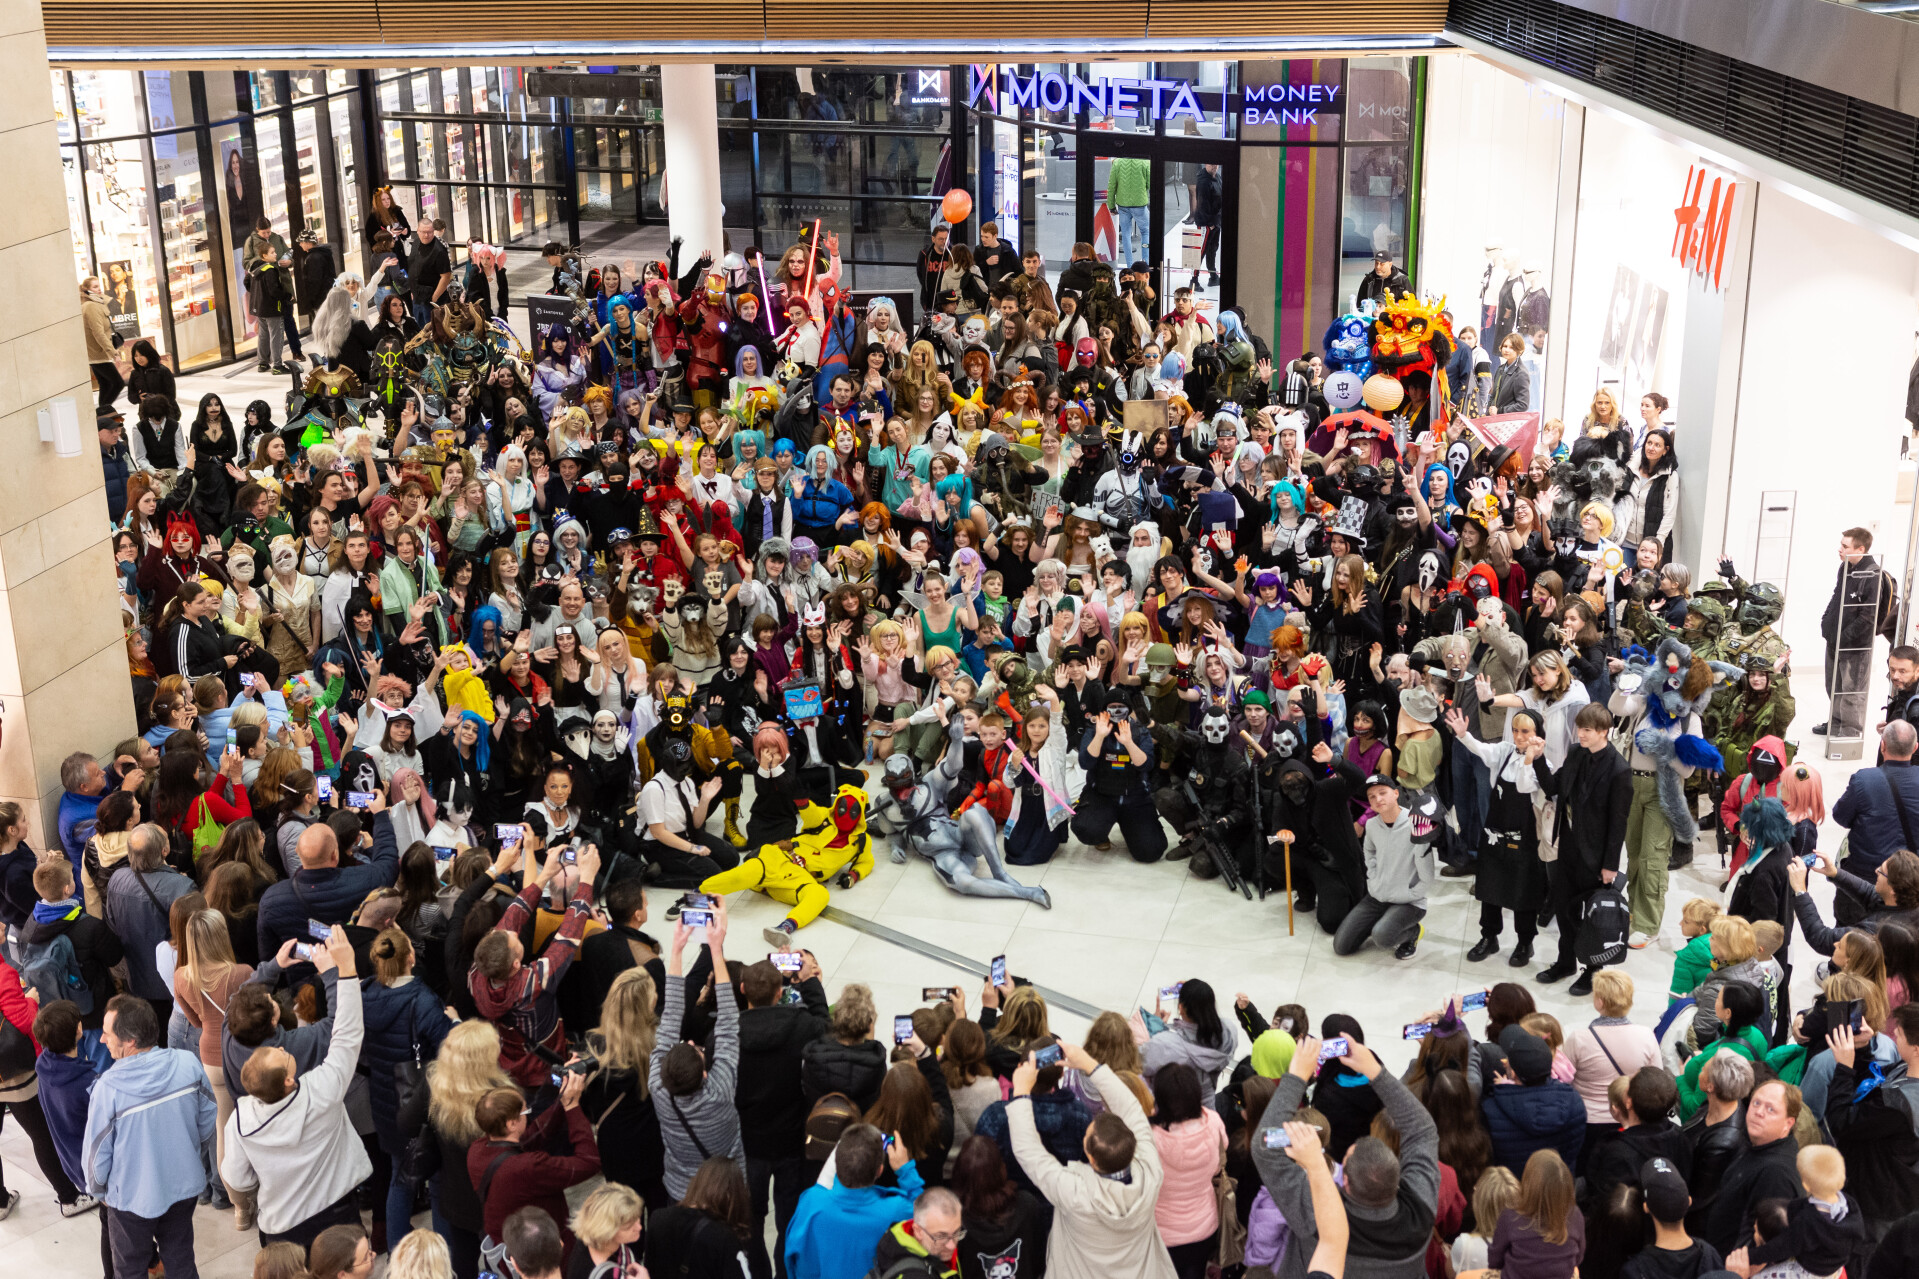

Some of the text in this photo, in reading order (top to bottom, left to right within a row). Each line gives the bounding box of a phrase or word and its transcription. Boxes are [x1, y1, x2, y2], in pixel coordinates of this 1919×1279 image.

[1008, 67, 1206, 122] MONETA
[1245, 84, 1340, 103] MONEY
[1245, 107, 1318, 126] BANK
[1671, 164, 1737, 290] H&M
[109, 312, 138, 324] LIBRE
[1336, 381, 1350, 400] 忠
[1032, 503, 1046, 519] HU
[1040, 492, 1063, 512] FREE
